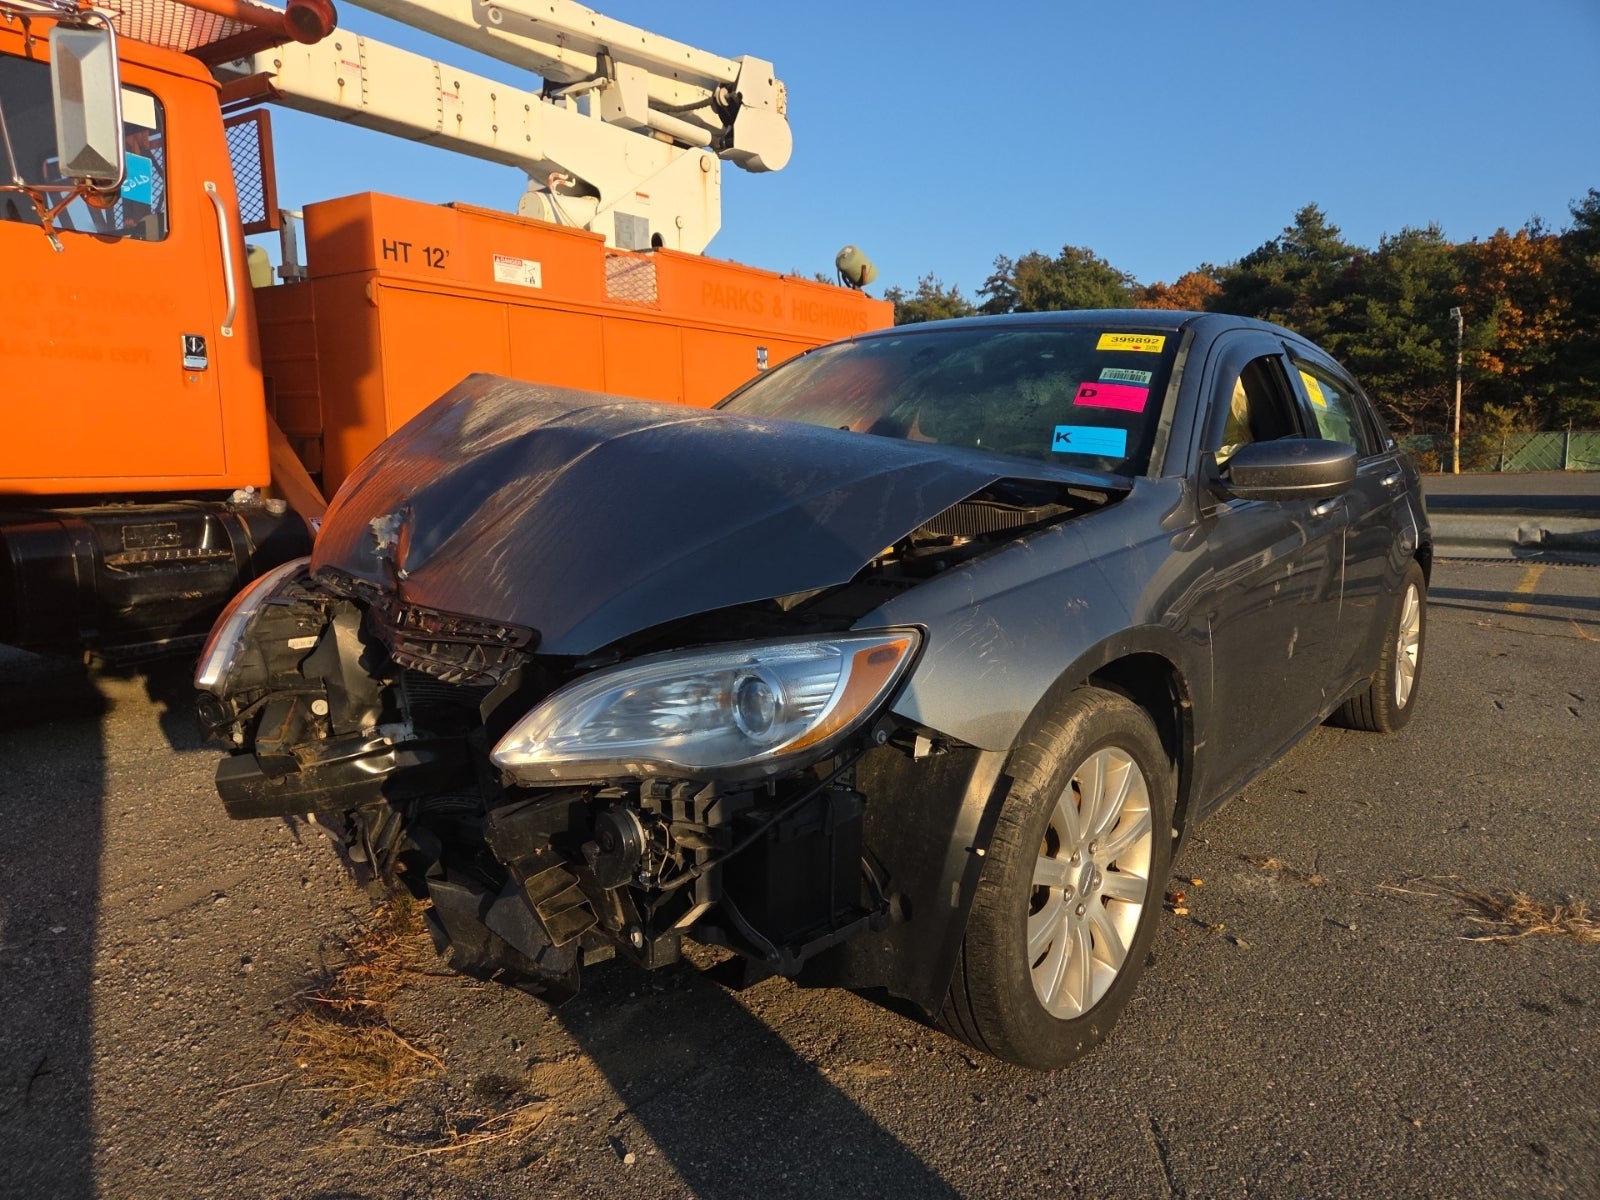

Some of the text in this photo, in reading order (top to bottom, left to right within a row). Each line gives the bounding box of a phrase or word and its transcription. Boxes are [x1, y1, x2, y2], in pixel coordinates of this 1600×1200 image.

[382, 238, 412, 263] HT
[701, 280, 868, 332] PARKS & HIGHWAYS
[1111, 336, 1159, 345] 399892
[1079, 389, 1097, 398] D
[1055, 432, 1072, 443] K
